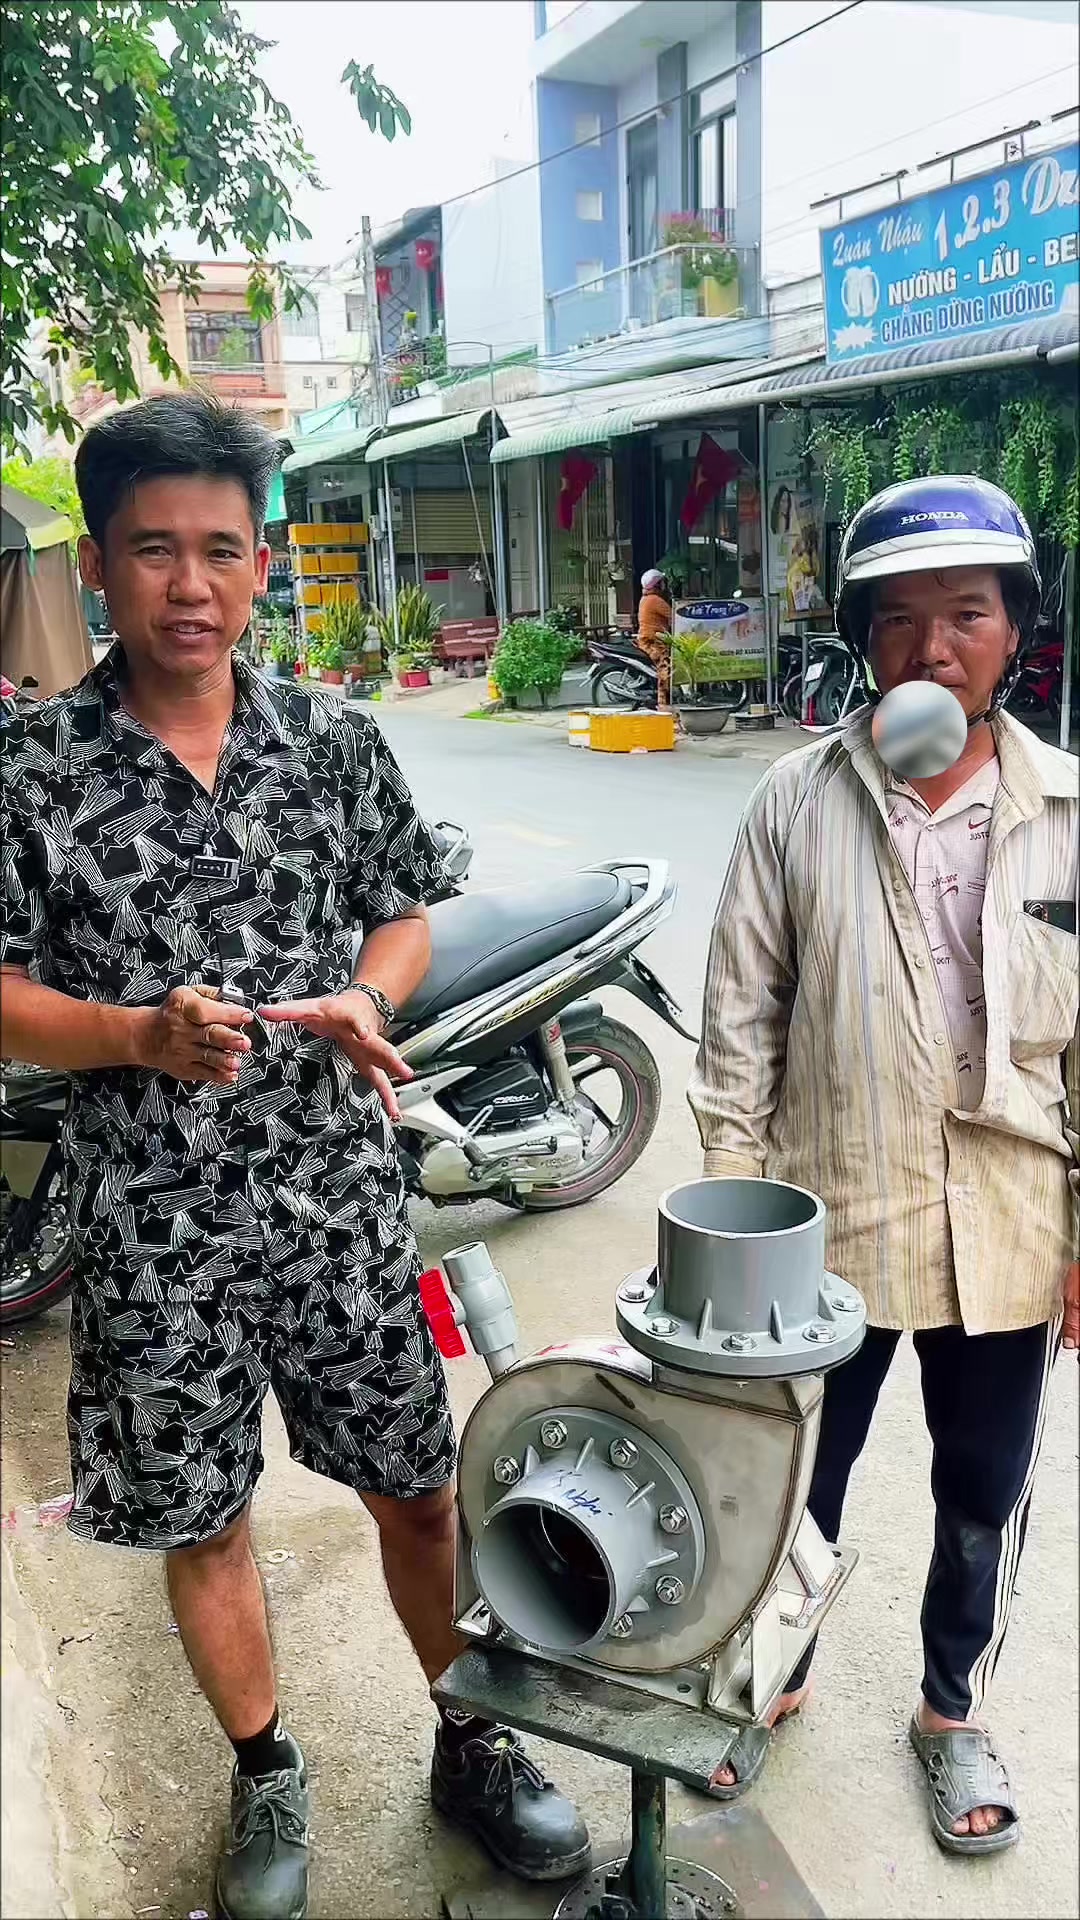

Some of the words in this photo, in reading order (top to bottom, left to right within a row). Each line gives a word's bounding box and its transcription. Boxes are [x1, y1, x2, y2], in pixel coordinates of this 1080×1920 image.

[877, 213, 924, 256] Nhậu
[1044, 232, 1079, 268] BE
[900, 511, 970, 525] HONDA
